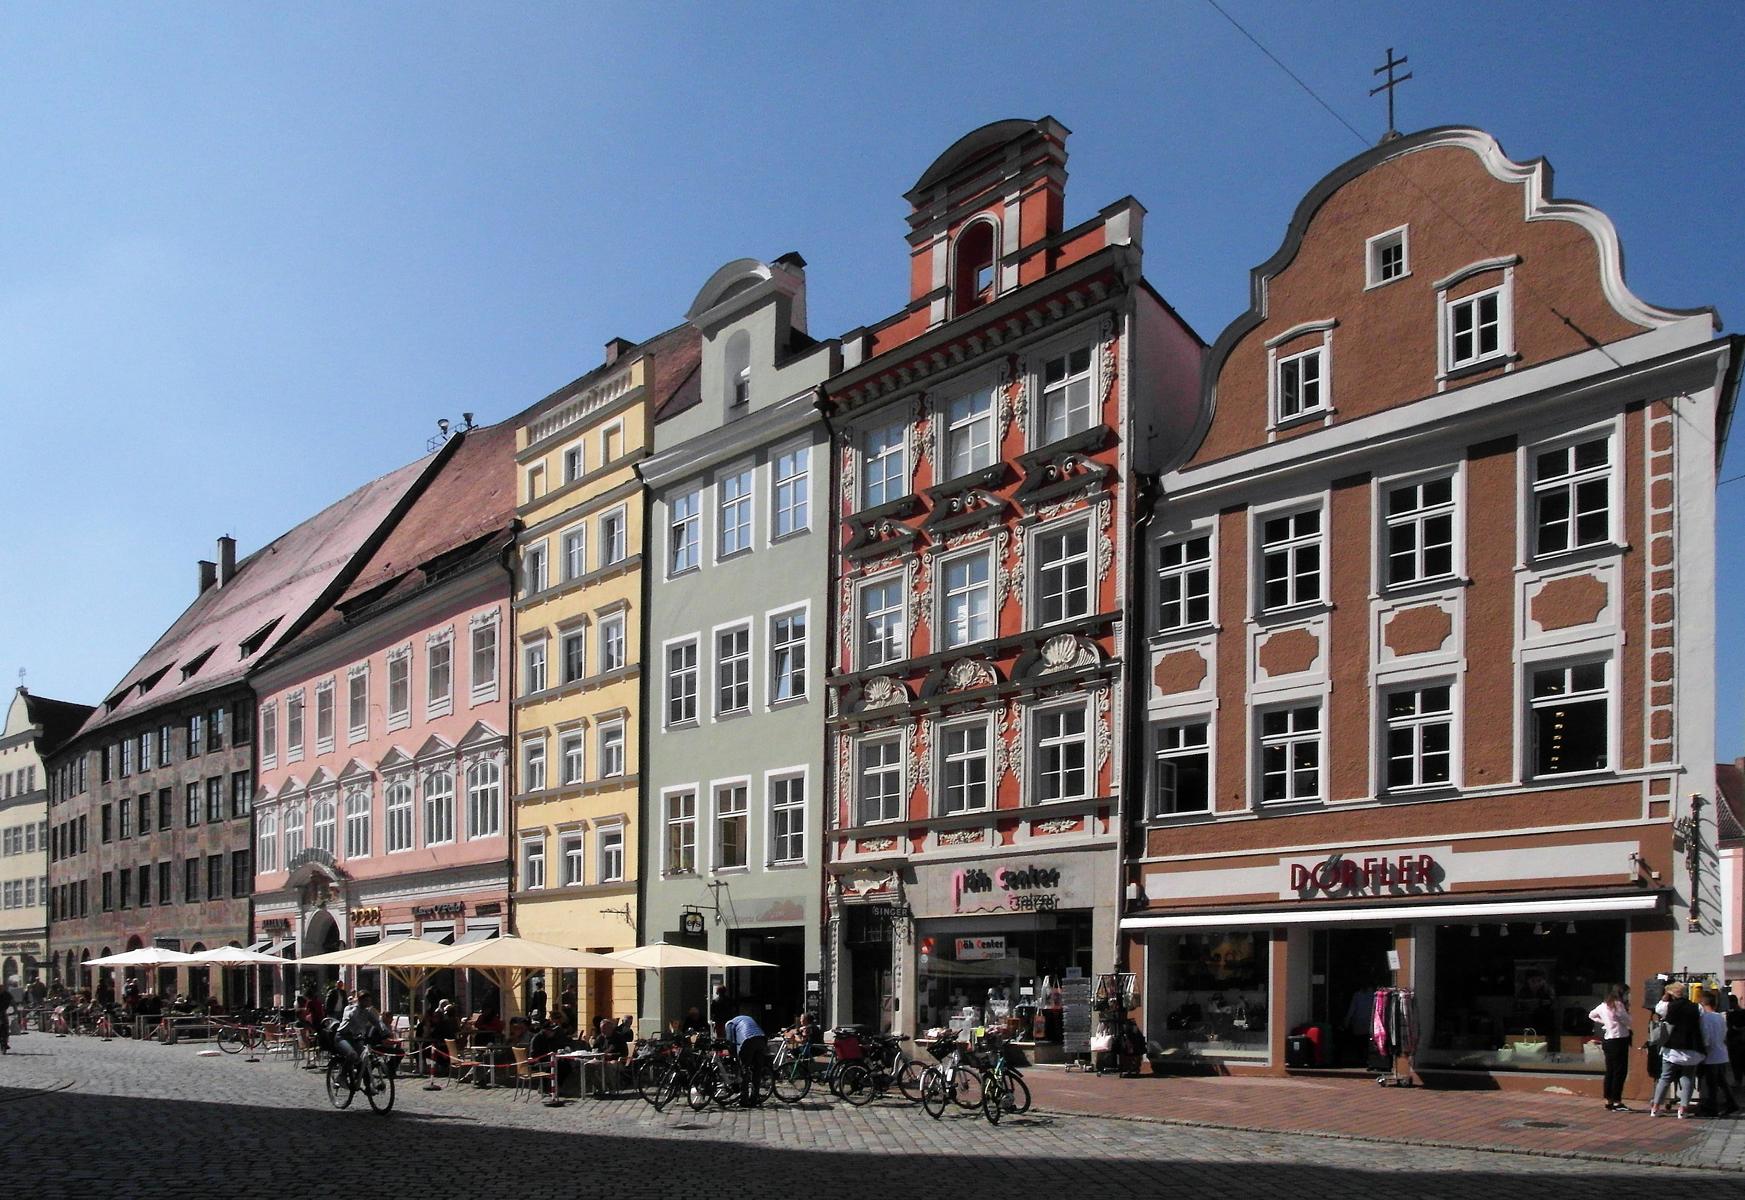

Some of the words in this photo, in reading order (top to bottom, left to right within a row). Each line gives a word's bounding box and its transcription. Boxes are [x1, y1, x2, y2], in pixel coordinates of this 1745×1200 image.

[995, 865, 1060, 891] Center
[1291, 854, 1434, 891] DÖRFLER
[873, 906, 908, 916] SINGER
[976, 938, 1004, 949] Center
